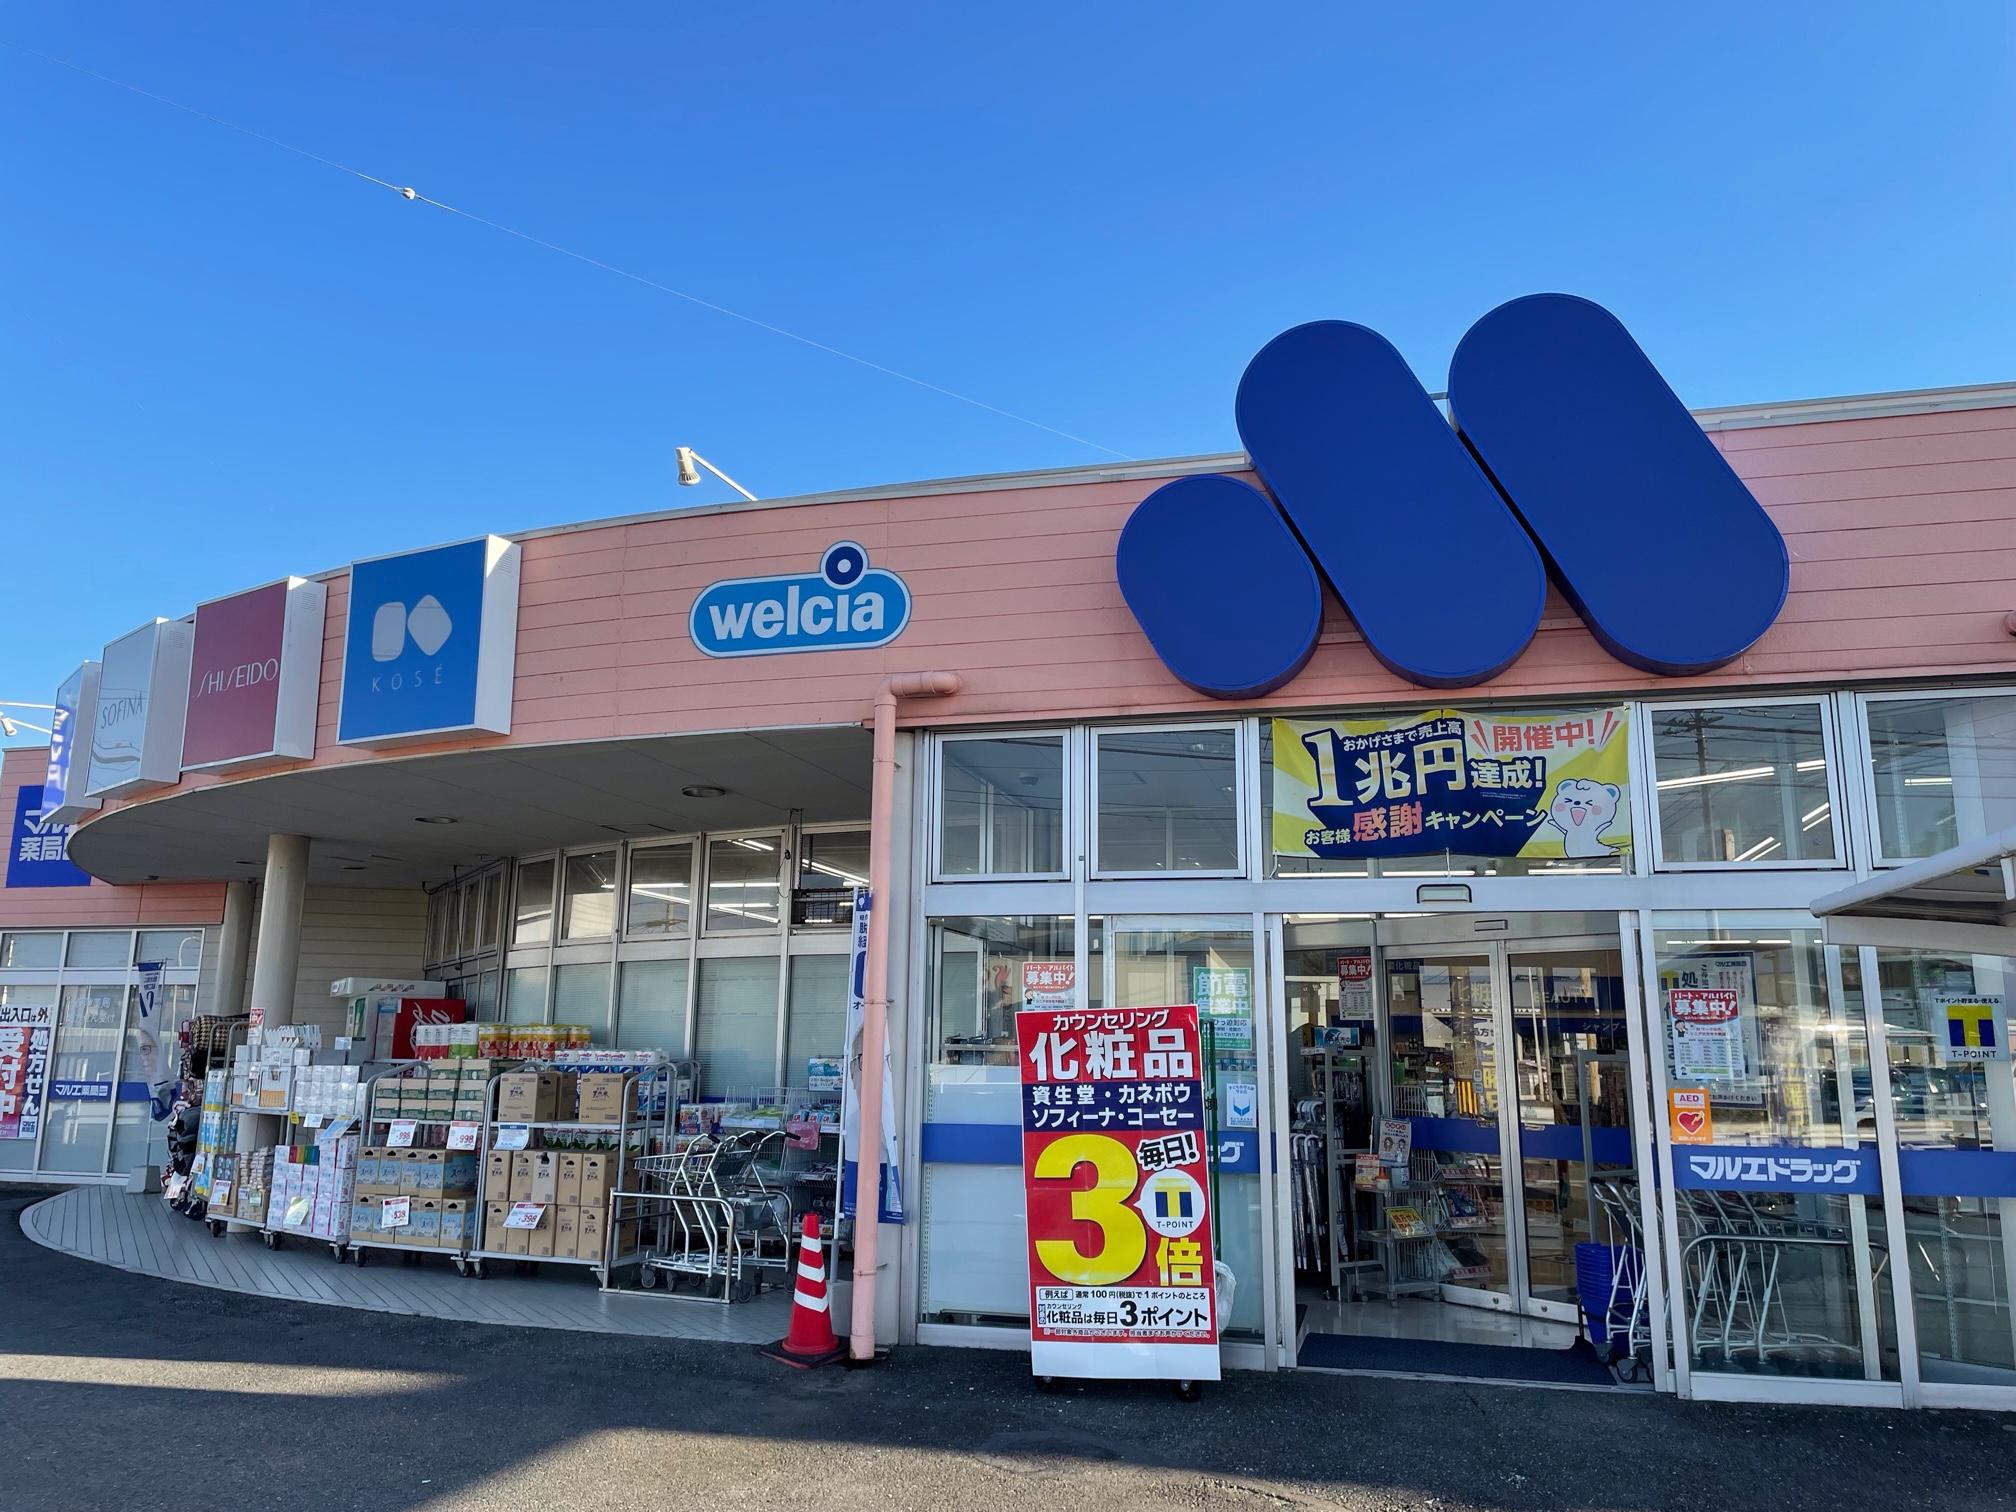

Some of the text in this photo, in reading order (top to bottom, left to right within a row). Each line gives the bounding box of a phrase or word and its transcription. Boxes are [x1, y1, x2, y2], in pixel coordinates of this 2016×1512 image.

[709, 562, 884, 640] welcia
[193, 658, 279, 698] SHISEIDO
[372, 664, 443, 692] KOSÉ
[101, 691, 142, 729] SOFINA
[1343, 721, 1463, 752] おかげさまで売上高
[1493, 719, 1596, 752] 開催中!
[1053, 1009, 1169, 1031] カウンセリング
[1029, 1029, 1194, 1081] 化粧品
[1952, 1050, 1996, 1058] T-POINT
[22, 1029, 48, 1116] 処方せん
[1032, 1083, 1191, 1106] 資生堂・カネボウ
[1680, 1094, 1699, 1102] AED
[1032, 1107, 1195, 1128] ソフィーナ・コーセー
[1139, 1133, 1198, 1167] 毎日!
[1690, 1155, 1861, 1184] マルエドラッグ
[1034, 1133, 1147, 1286] 3
[1156, 1220, 1193, 1229] T-POINT
[1155, 1238, 1204, 1287] 倍
[1045, 1290, 1068, 1299] 例えば
[1047, 1303, 1082, 1311] カウンセリング
